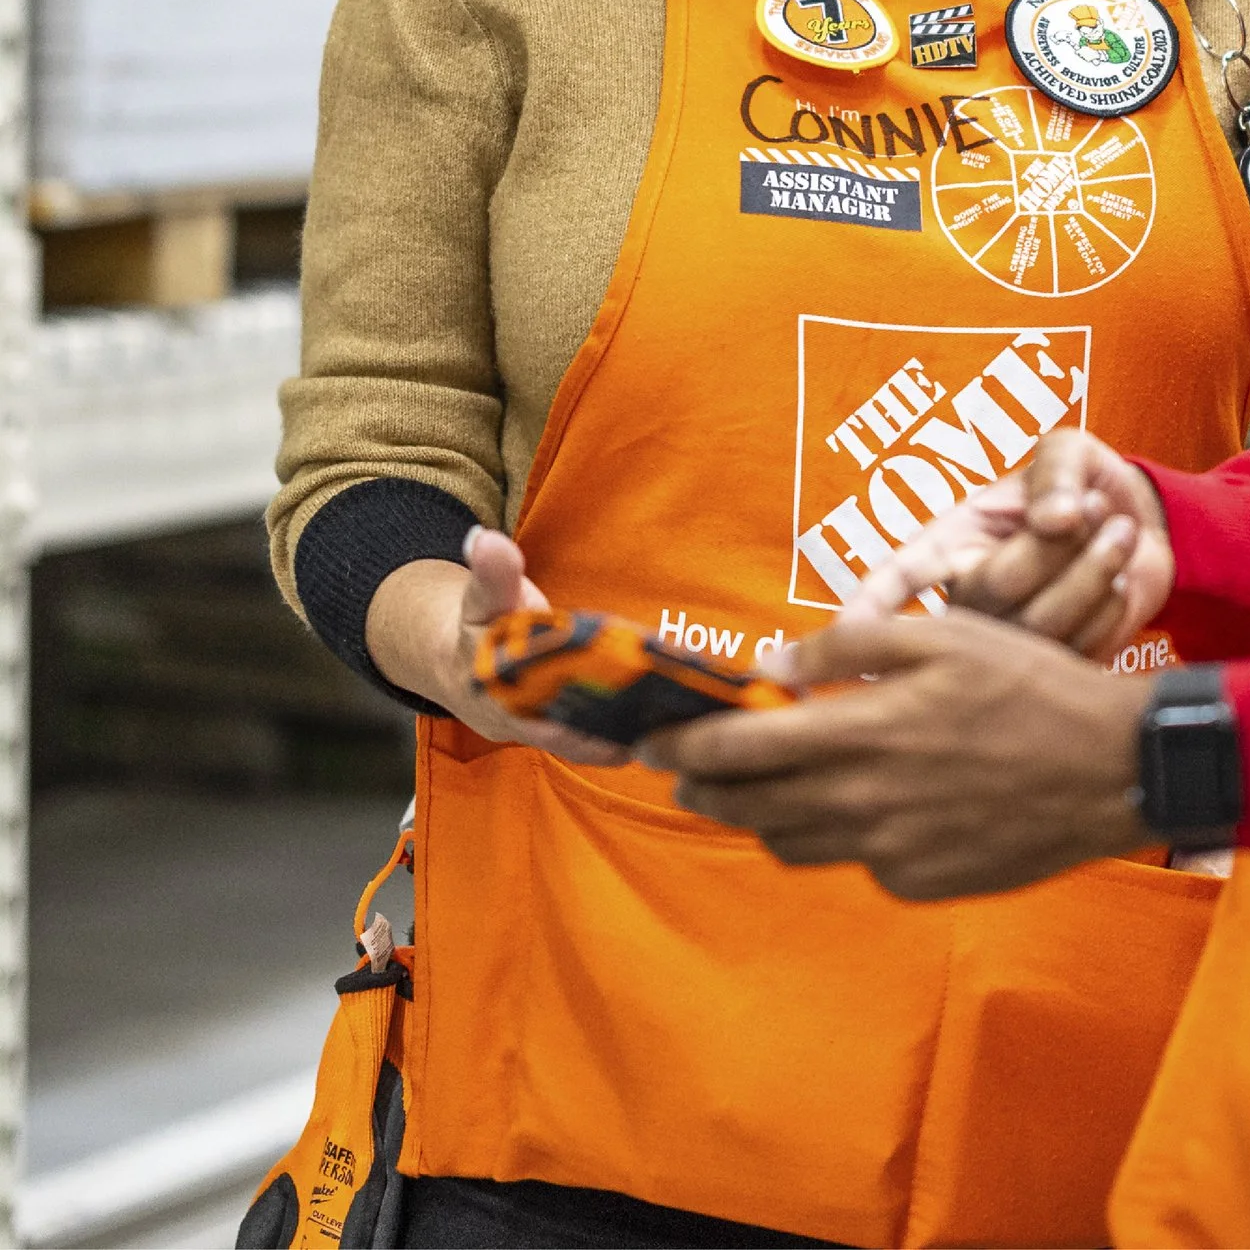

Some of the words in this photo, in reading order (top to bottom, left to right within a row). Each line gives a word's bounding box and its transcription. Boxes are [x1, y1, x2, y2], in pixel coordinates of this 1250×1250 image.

[807, 17, 870, 43] Years
[1152, 29, 1168, 54] 2023
[794, 39, 859, 59] SERVICE
[913, 33, 974, 66] HDTV
[1037, 16, 1060, 67] AWARENESS
[1061, 67, 1121, 87] BEHAVIOR
[1122, 36, 1145, 77] CULTURE
[1022, 51, 1087, 102] ACHIEVED
[1141, 54, 1166, 87] GOAL
[1090, 82, 1146, 105] SHRINK
[961, 151, 990, 163] GIVING
[961, 157, 985, 169] BACK
[762, 170, 898, 205] ASSISTANT
[770, 189, 892, 222] MANAGER
[953, 203, 981, 222] DOING
[982, 193, 1000, 206] THE
[984, 196, 1012, 213] THING
[1100, 205, 1132, 221] SPIRIT
[1010, 225, 1028, 272] CREATING
[1014, 216, 1038, 284] SHAREHOLDER
[1026, 237, 1041, 268] VALUE
[1063, 224, 1077, 240] ALL
[1074, 240, 1098, 275] PEOPLE
[1068, 215, 1096, 254] RESPECT
[1092, 255, 1106, 274] FOR
[826, 358, 947, 471] THE
[797, 331, 1086, 608] HOME
[658, 609, 745, 658] How
[313, 1210, 325, 1220] CUT
[326, 1216, 342, 1229] LEVE
